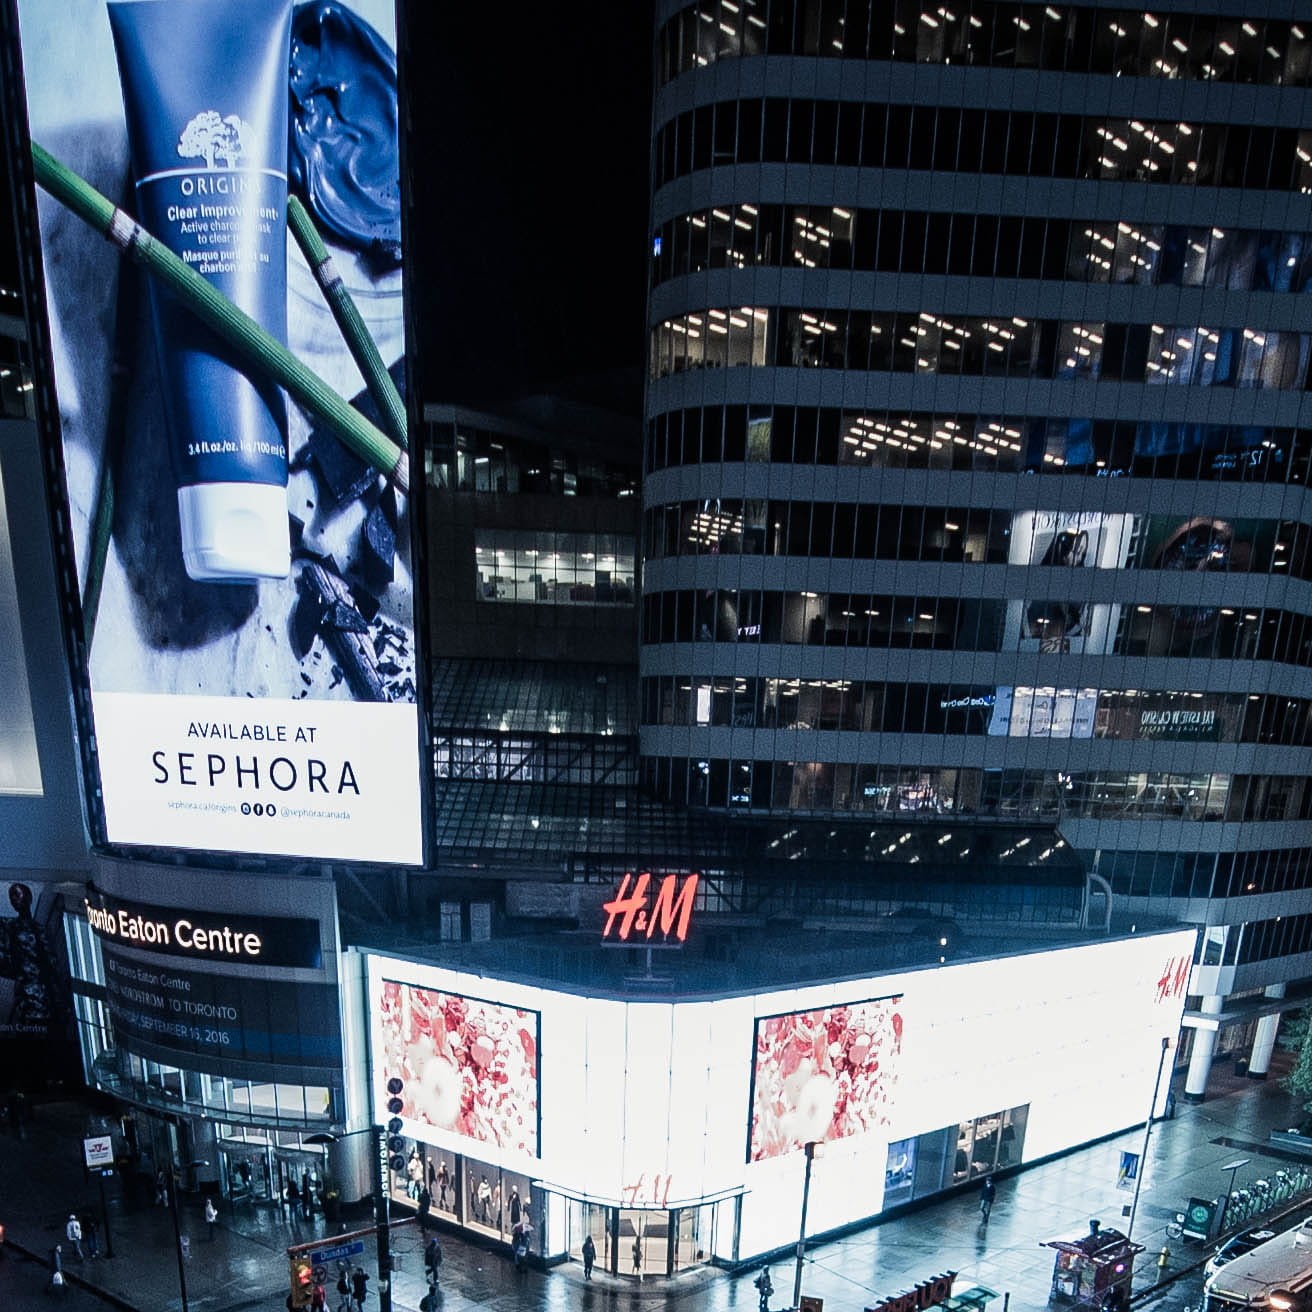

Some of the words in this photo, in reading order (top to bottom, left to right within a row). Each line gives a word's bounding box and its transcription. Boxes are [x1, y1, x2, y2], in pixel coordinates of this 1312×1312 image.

[168, 205, 198, 222] Clear
[200, 204, 276, 221] Improvent
[181, 220, 208, 234] Active
[198, 234, 208, 245] to
[182, 249, 219, 262] Masque
[187, 721, 287, 743] AVAILABLE
[294, 726, 318, 744] AT
[151, 750, 361, 796] SEPHORA
[602, 872, 699, 942] H&M
[118, 910, 170, 945] Eaton
[174, 919, 262, 955] Centre
[160, 973, 192, 992] Centre
[168, 998, 182, 1013] TO
[184, 1000, 238, 1021] TORONTO
[205, 1029, 231, 1045] 2016
